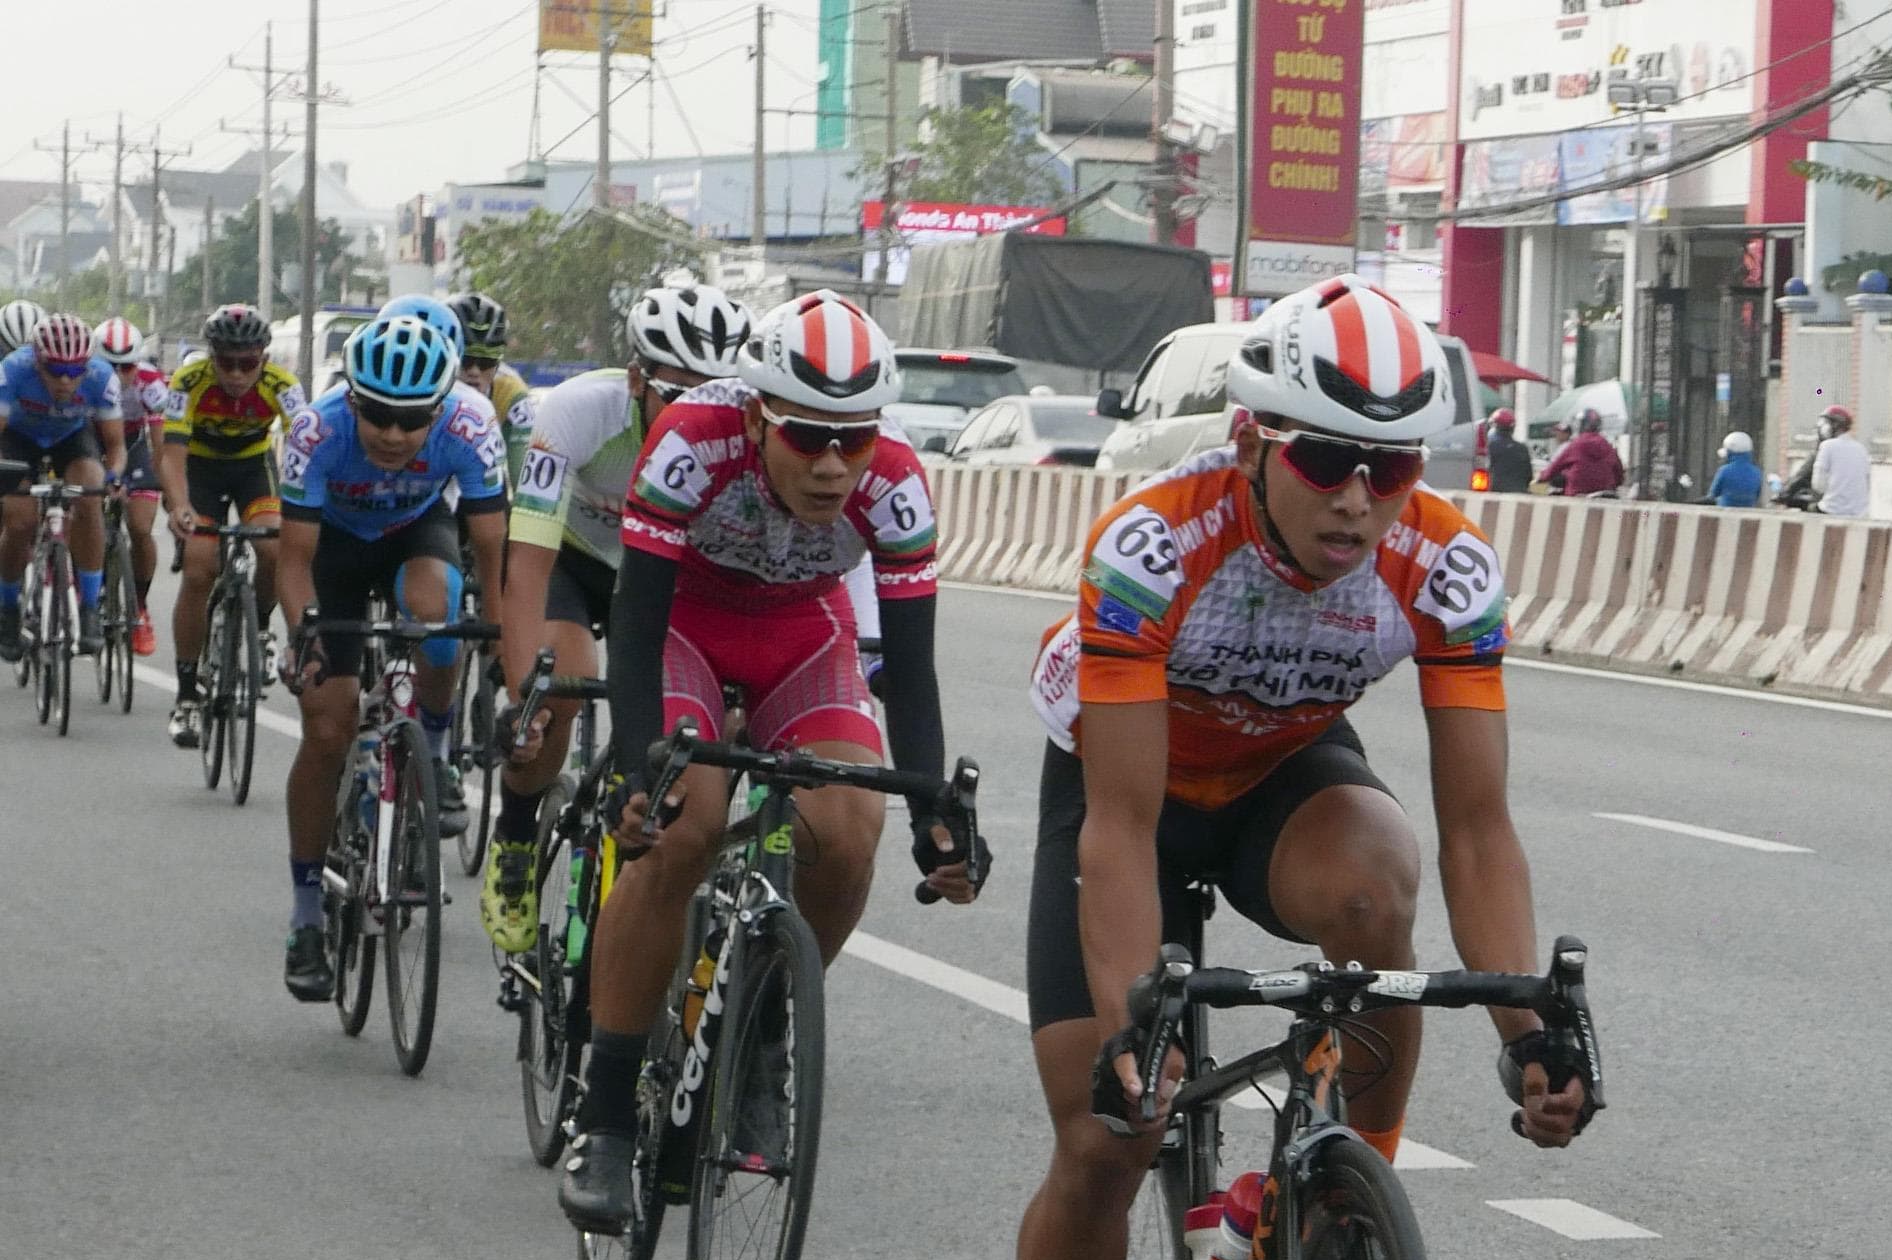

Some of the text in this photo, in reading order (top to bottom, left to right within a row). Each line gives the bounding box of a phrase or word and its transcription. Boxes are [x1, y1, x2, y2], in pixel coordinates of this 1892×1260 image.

[1316, 91, 1344, 118] RA
[897, 208, 950, 229] onda
[520, 450, 556, 490] 60
[663, 454, 696, 489] 6
[889, 491, 917, 531] 6
[1429, 544, 1490, 615] 69
